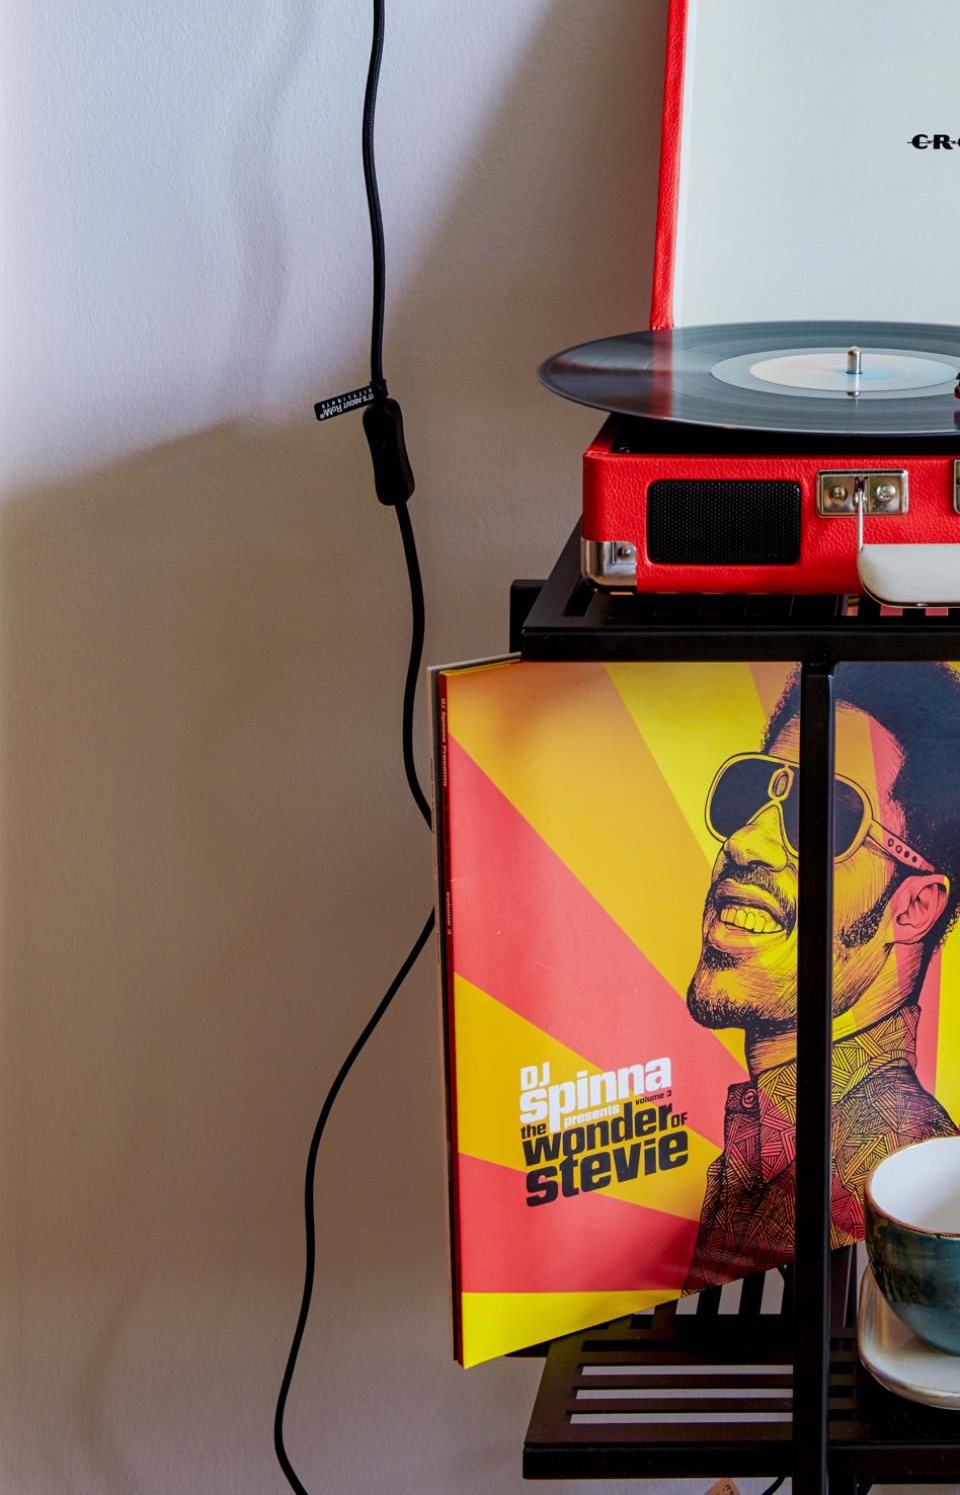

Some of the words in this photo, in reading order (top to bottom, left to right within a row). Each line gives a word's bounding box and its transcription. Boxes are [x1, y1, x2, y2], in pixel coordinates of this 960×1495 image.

[342, 397, 362, 409] ABOUT
[520, 1061, 550, 1091] DJ
[564, 1104, 620, 1128] presents
[635, 1092, 664, 1105] volume
[666, 1089, 673, 1097] 3
[520, 1122, 546, 1139] the
[522, 1101, 673, 1167] wonder
[671, 1112, 688, 1128] OF
[526, 1130, 689, 1207] stevie
